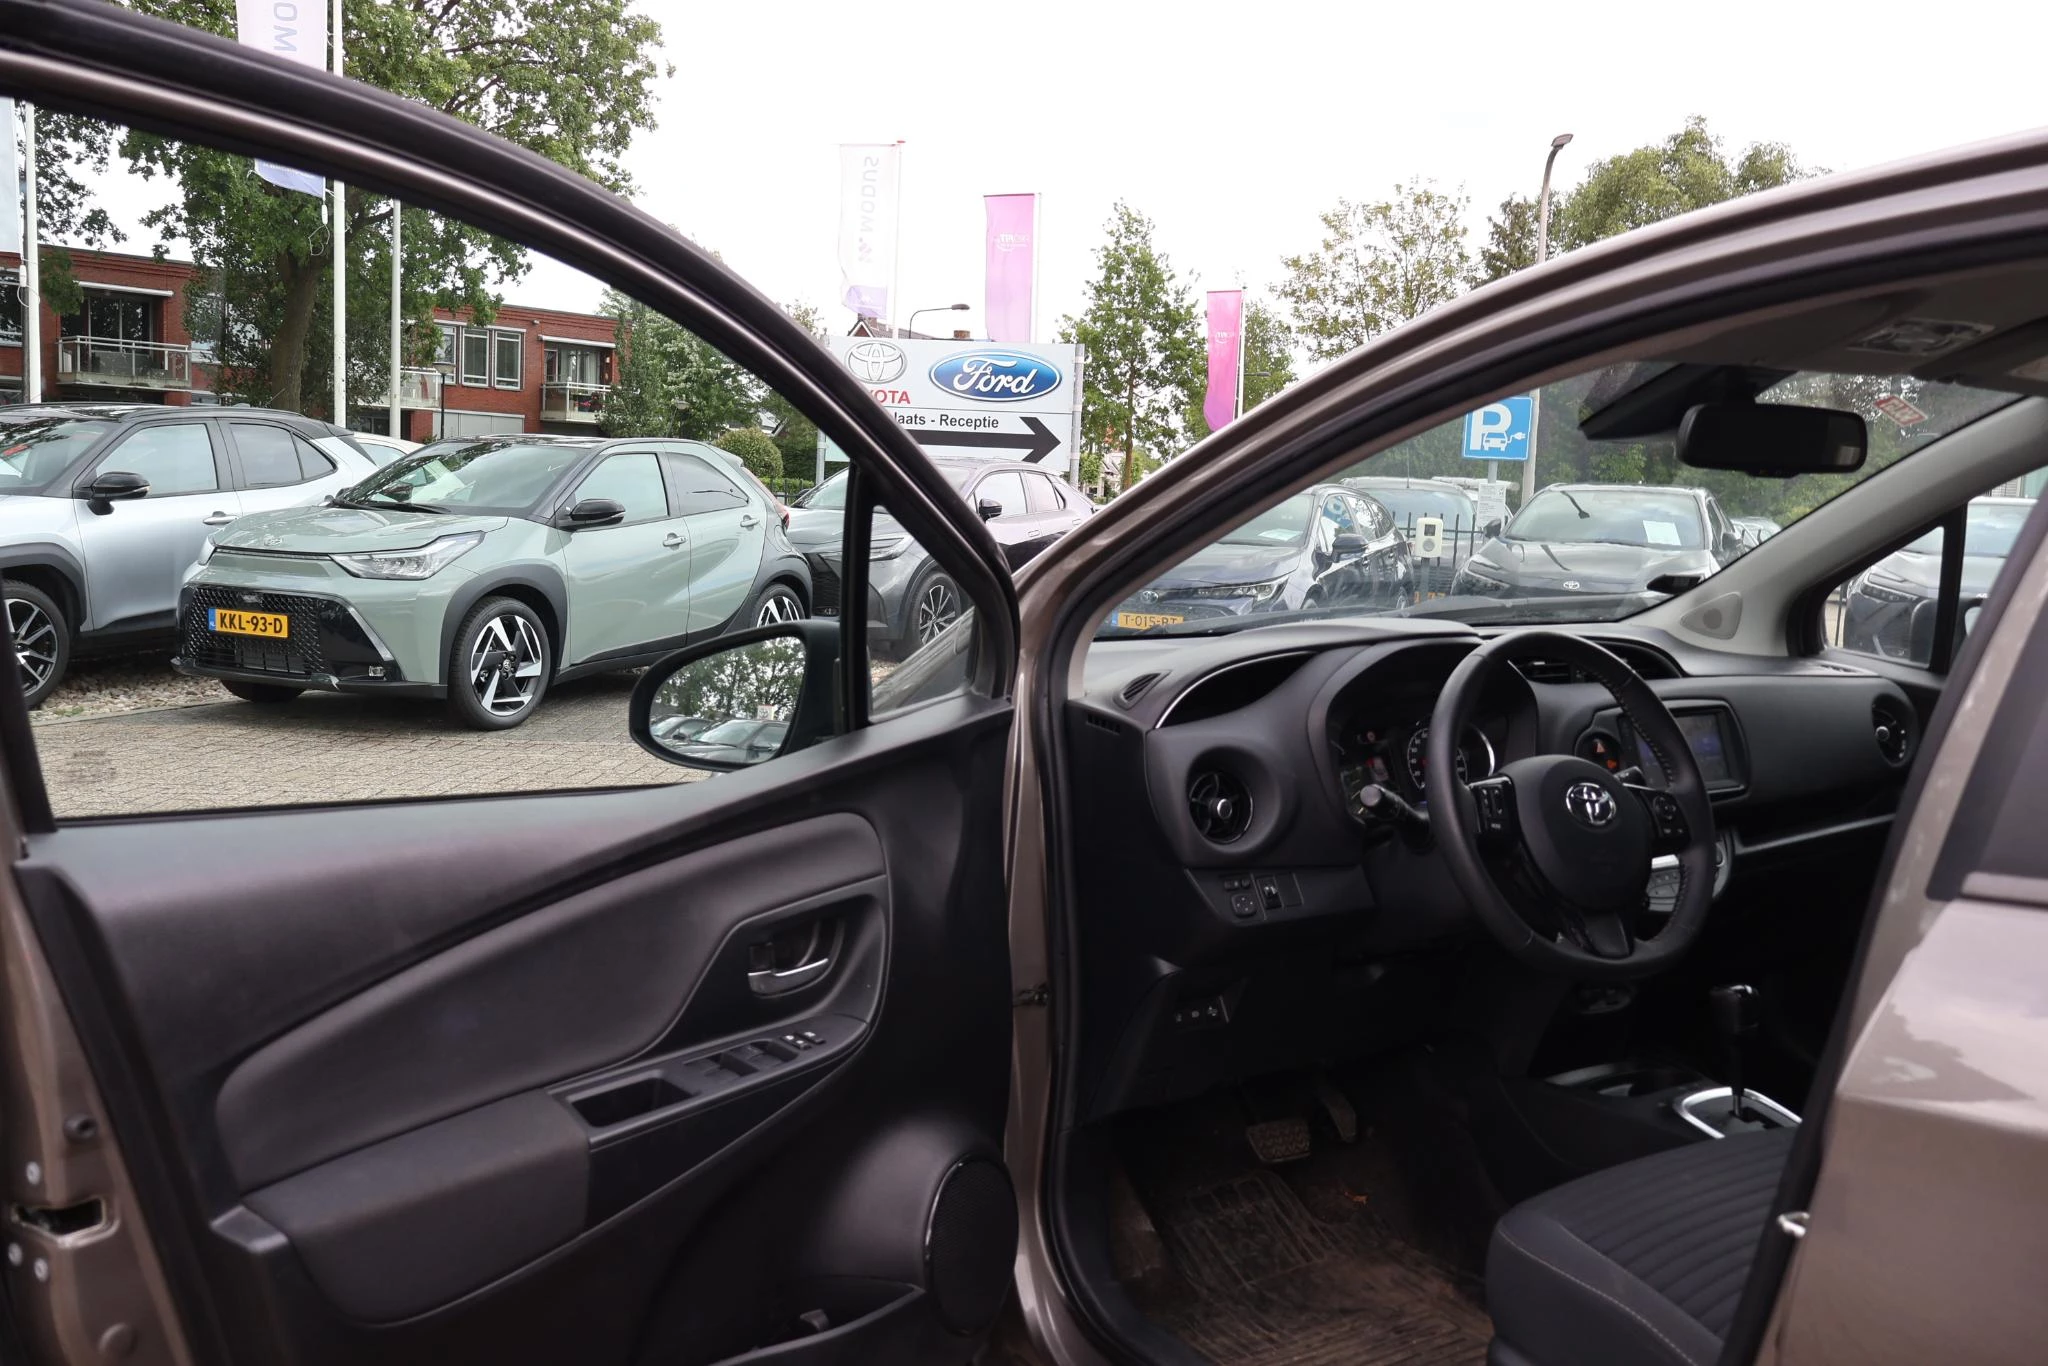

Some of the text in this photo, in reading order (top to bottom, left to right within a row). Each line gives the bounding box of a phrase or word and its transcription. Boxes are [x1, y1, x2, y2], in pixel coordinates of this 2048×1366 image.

[952, 356, 1039, 394] Ford
[871, 389, 911, 405] OTA
[939, 414, 999, 430] Receptie
[1469, 403, 1512, 450] P
[220, 612, 283, 634] KKL-93-D
